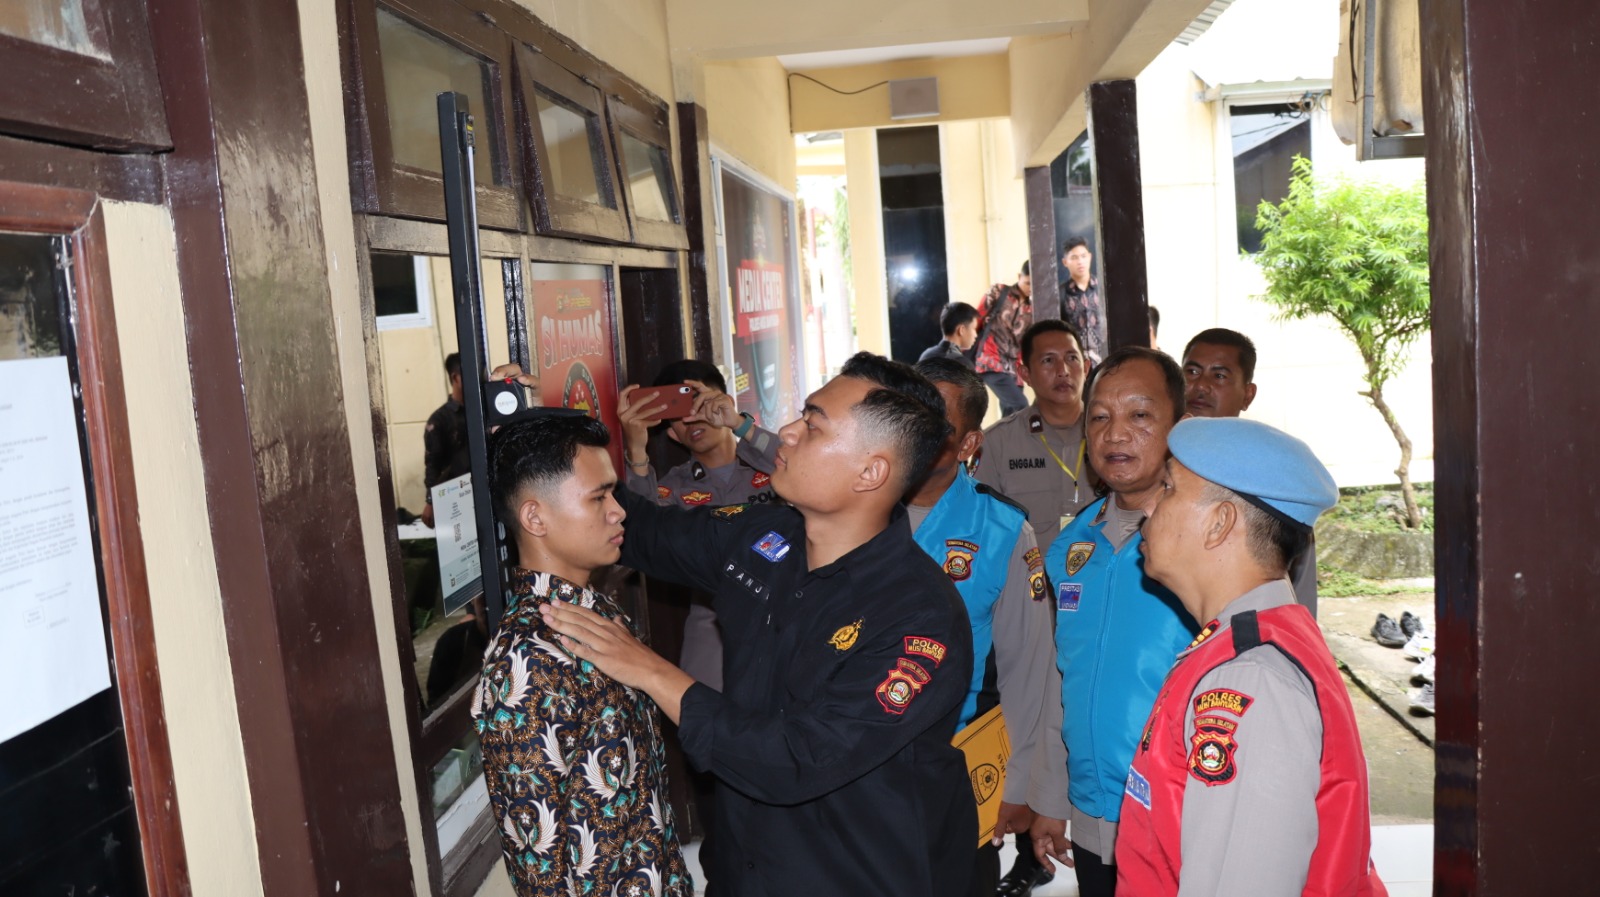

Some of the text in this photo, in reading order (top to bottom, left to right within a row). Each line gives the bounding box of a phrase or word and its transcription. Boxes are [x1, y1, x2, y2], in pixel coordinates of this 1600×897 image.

[737, 268, 784, 313] MEDIA CENTER
[542, 309, 604, 369] SI HUMAS
[1009, 457, 1046, 470] ENGGA.RM
[1201, 692, 1242, 704] POLRES
